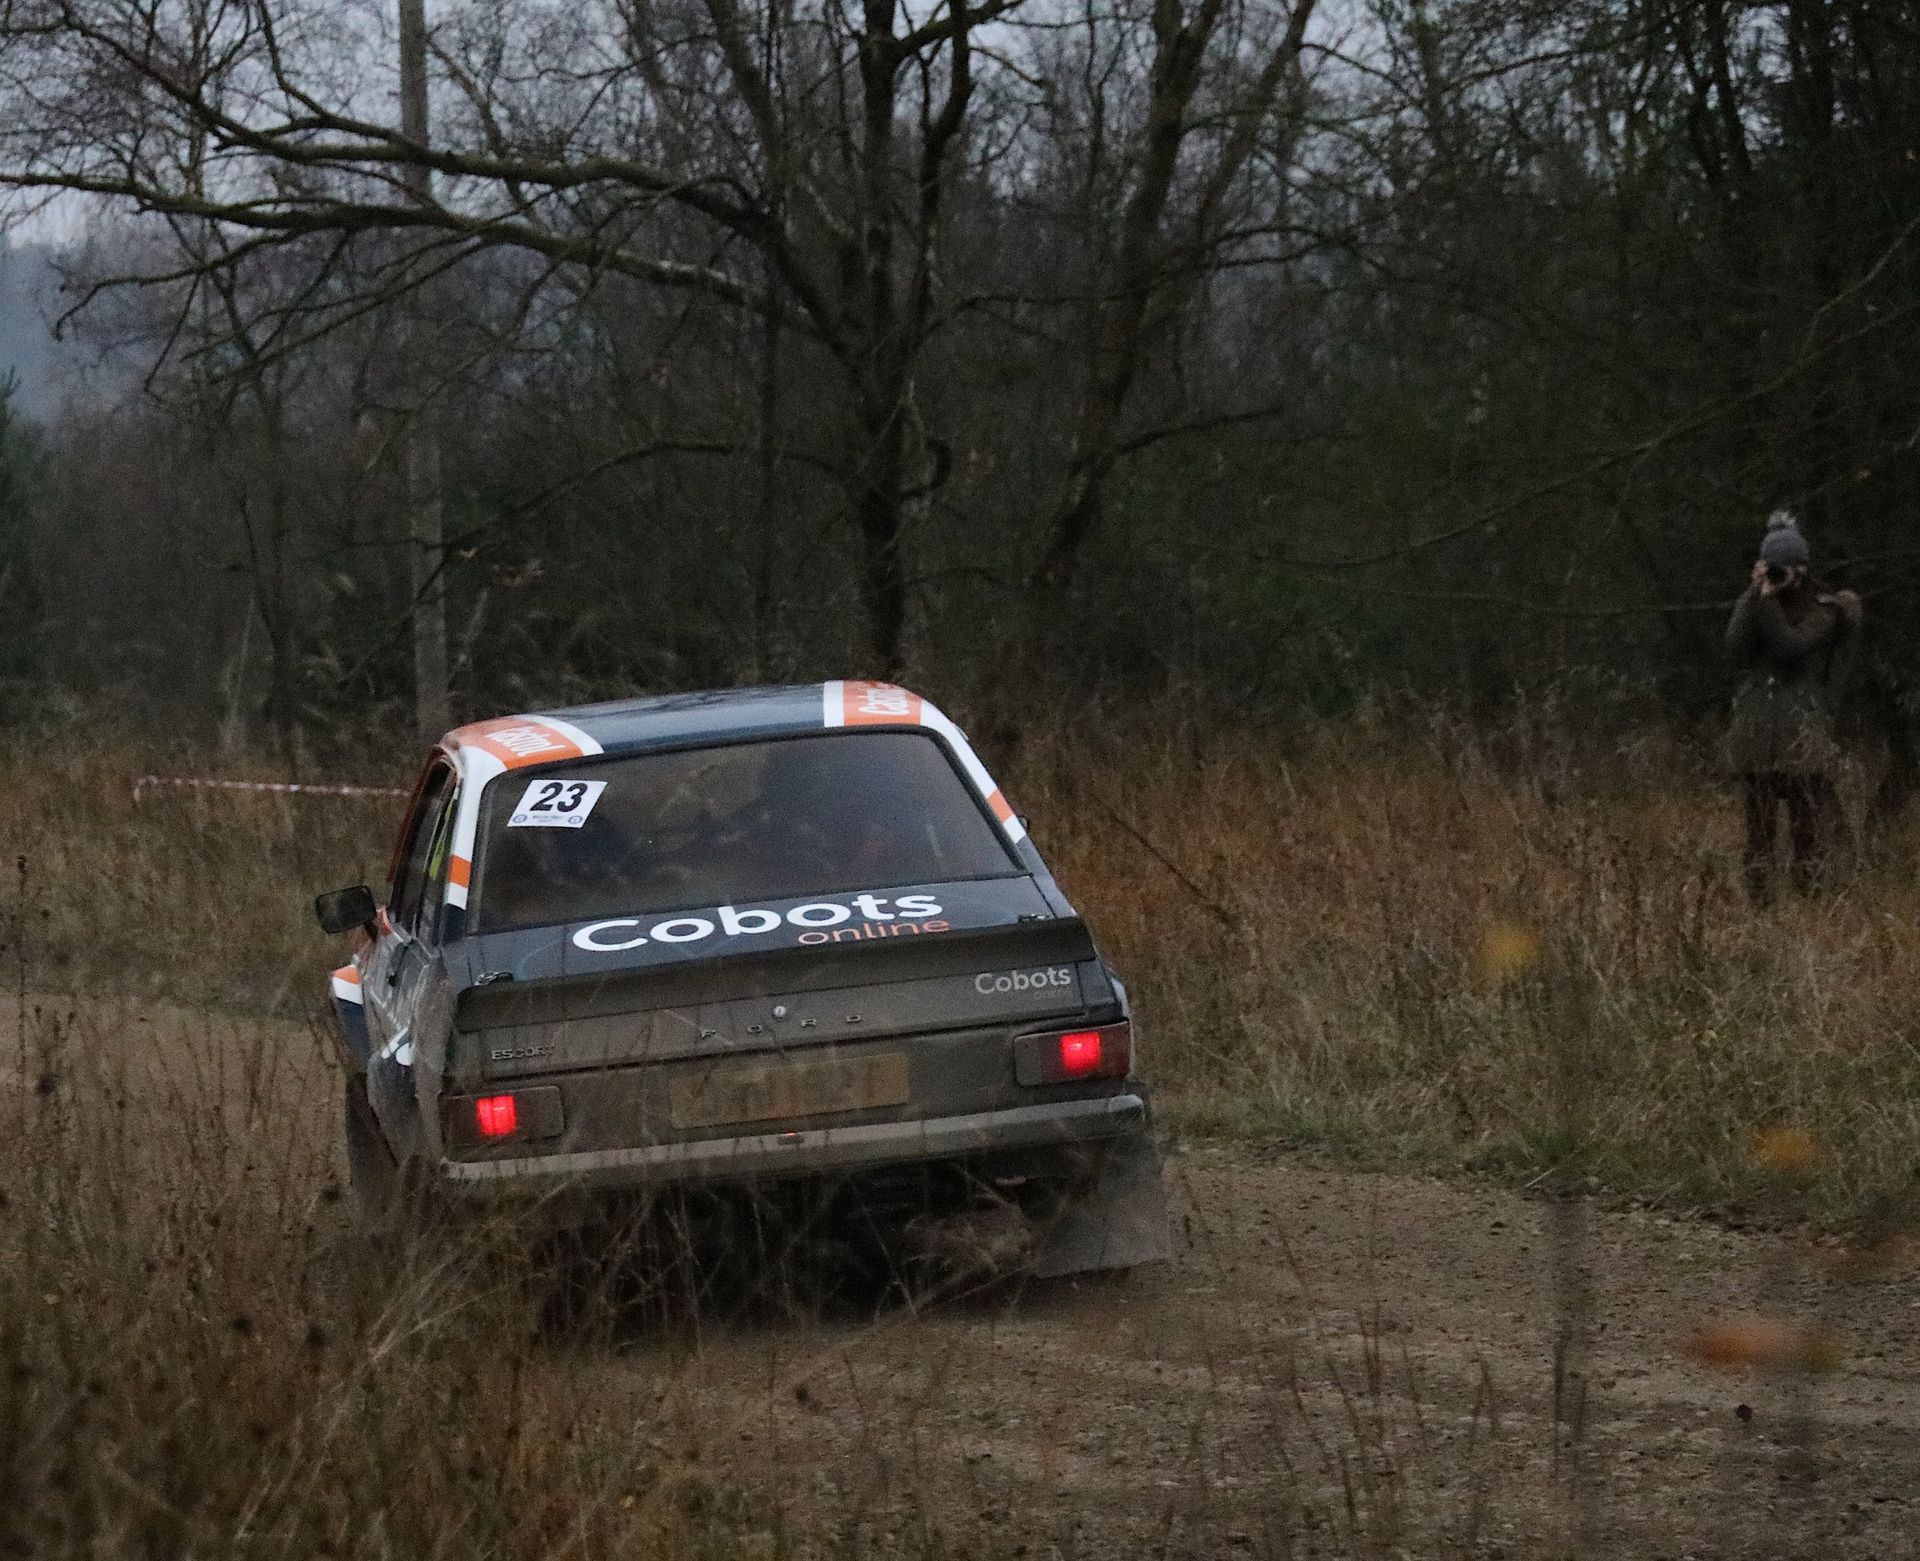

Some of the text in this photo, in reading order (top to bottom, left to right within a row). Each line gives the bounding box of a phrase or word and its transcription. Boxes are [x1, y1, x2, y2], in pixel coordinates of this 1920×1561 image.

[529, 781, 589, 813] 23
[572, 893, 943, 952] Cobots
[798, 917, 952, 946] online
[974, 967, 1072, 994] Cobots
